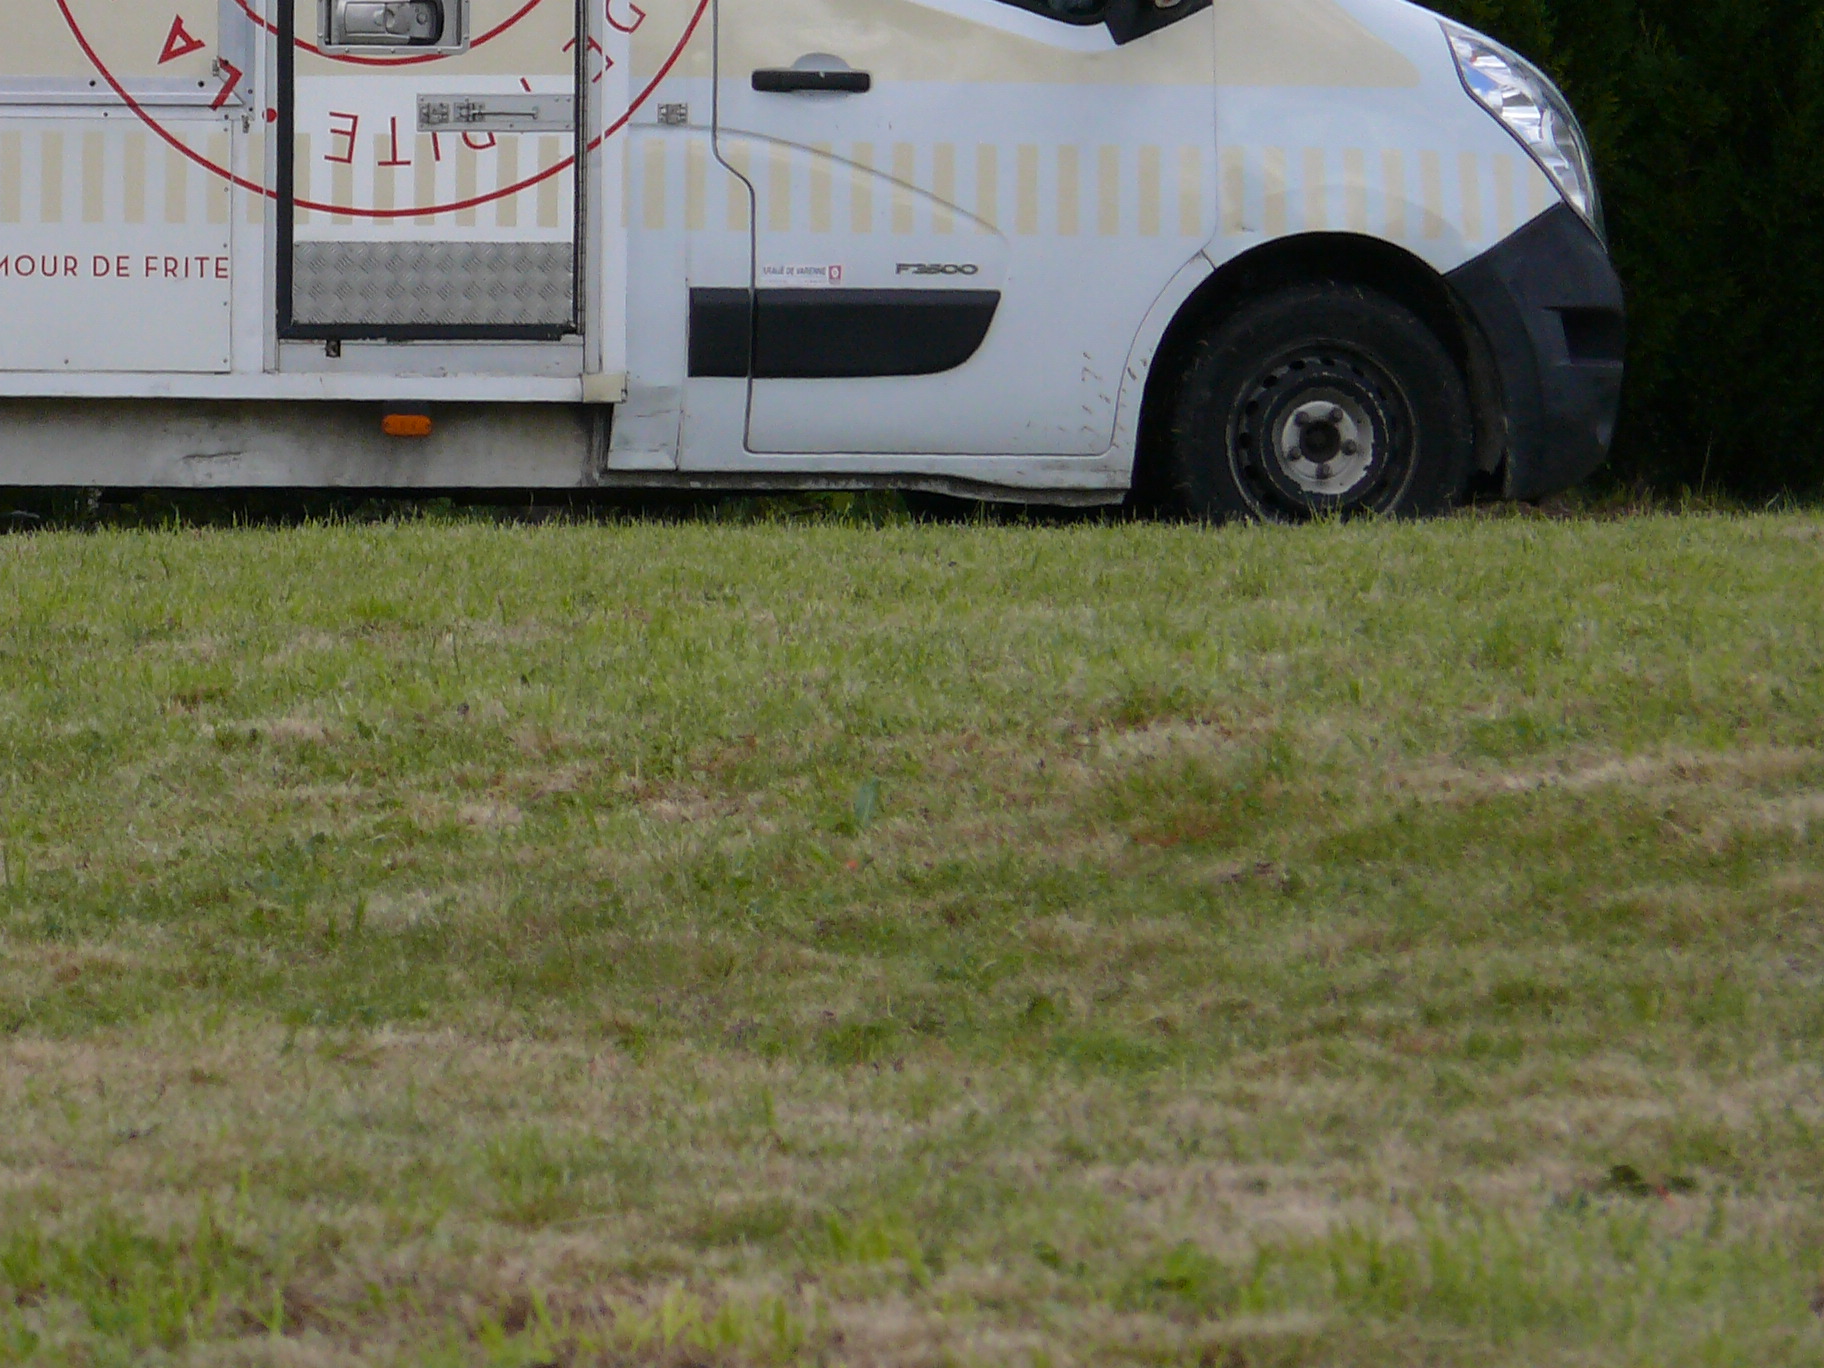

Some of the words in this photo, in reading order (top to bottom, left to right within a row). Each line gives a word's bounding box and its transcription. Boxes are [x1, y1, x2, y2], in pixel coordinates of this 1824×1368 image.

[158, 14, 243, 111] LA
[92, 255, 130, 278] DE
[145, 256, 229, 279] FRITE
